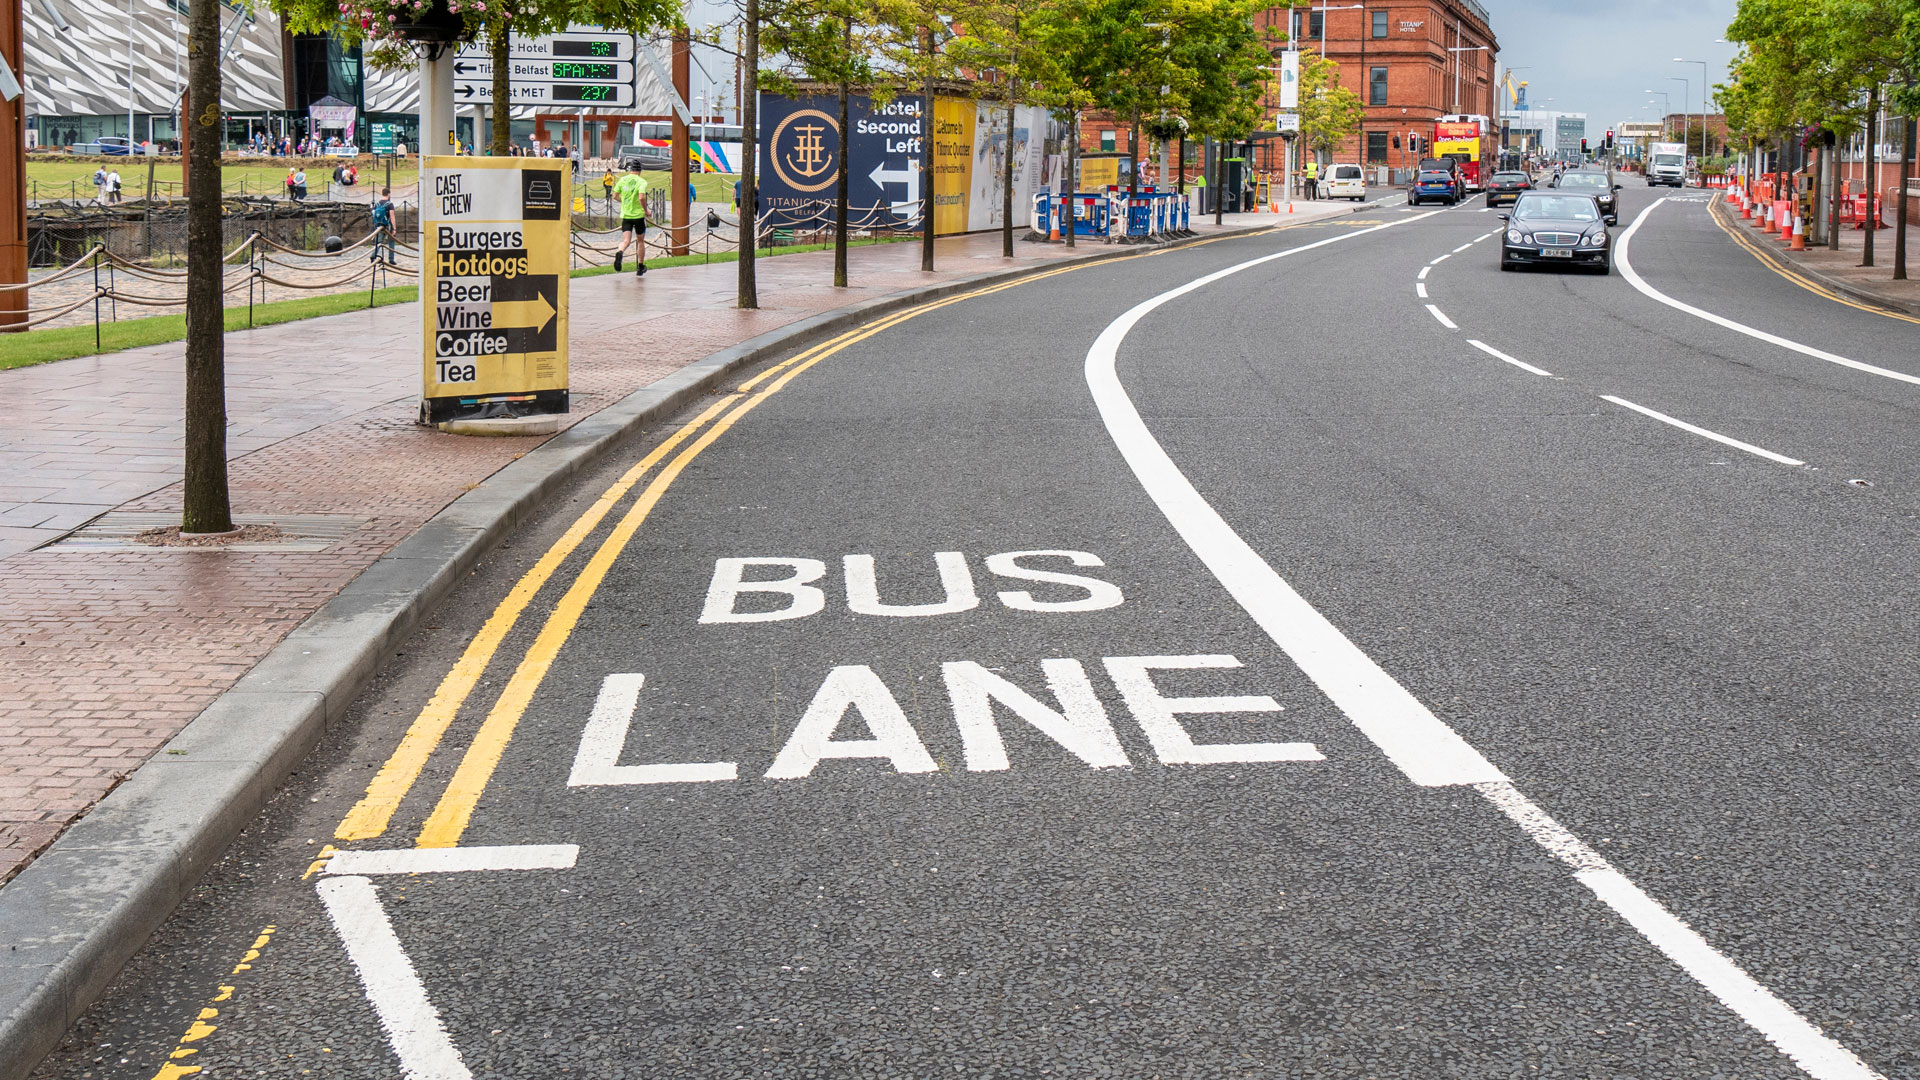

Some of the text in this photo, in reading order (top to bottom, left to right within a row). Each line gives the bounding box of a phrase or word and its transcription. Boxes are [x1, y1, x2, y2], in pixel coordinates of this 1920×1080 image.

[518, 44, 548, 52] Hotel
[514, 65, 548, 75] Belfast
[522, 88, 545, 97] MET
[857, 119, 921, 134] Second
[886, 138, 921, 153] Left
[436, 174, 462, 196] CAST
[442, 193, 472, 216] CREW
[766, 197, 812, 207] TITANIC
[438, 226, 522, 250] Burgers
[438, 252, 528, 279] Hotdogs
[438, 280, 490, 302] Beer
[437, 306, 492, 329] Wine
[436, 332, 508, 356] Coffee
[436, 360, 476, 382] Tea
[698, 550, 1124, 624] BUS
[566, 655, 1326, 787] LANE
